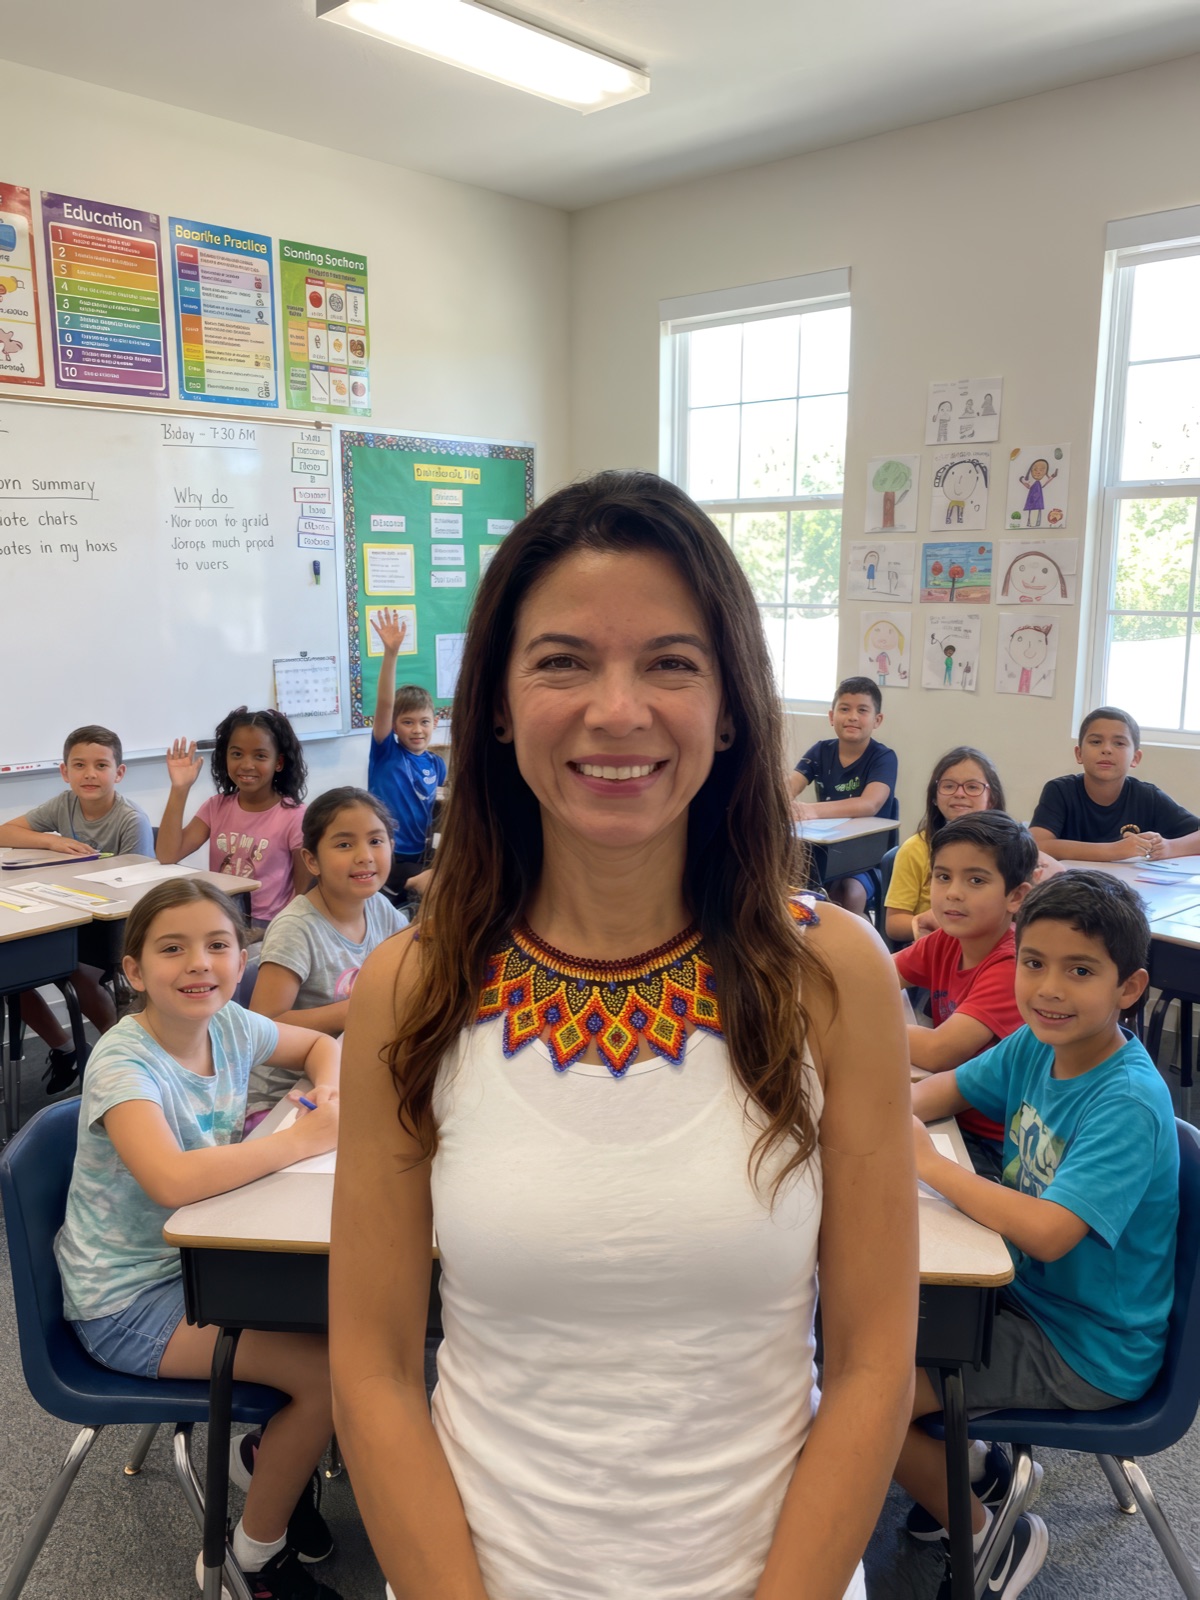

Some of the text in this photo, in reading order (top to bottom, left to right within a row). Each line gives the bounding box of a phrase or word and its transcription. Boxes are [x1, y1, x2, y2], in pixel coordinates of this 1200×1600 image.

[63, 202, 143, 232] Education
[58, 229, 63, 240] 1
[58, 246, 66, 258] 2
[61, 281, 69, 291] 4
[66, 349, 73, 359] 9
[64, 367, 77, 377] 10
[174, 486, 228, 511] Why do
[38, 510, 78, 526] chats
[212, 536, 241, 548] much
[40, 540, 53, 553] in
[60, 543, 79, 563] my
[176, 558, 189, 571] to
